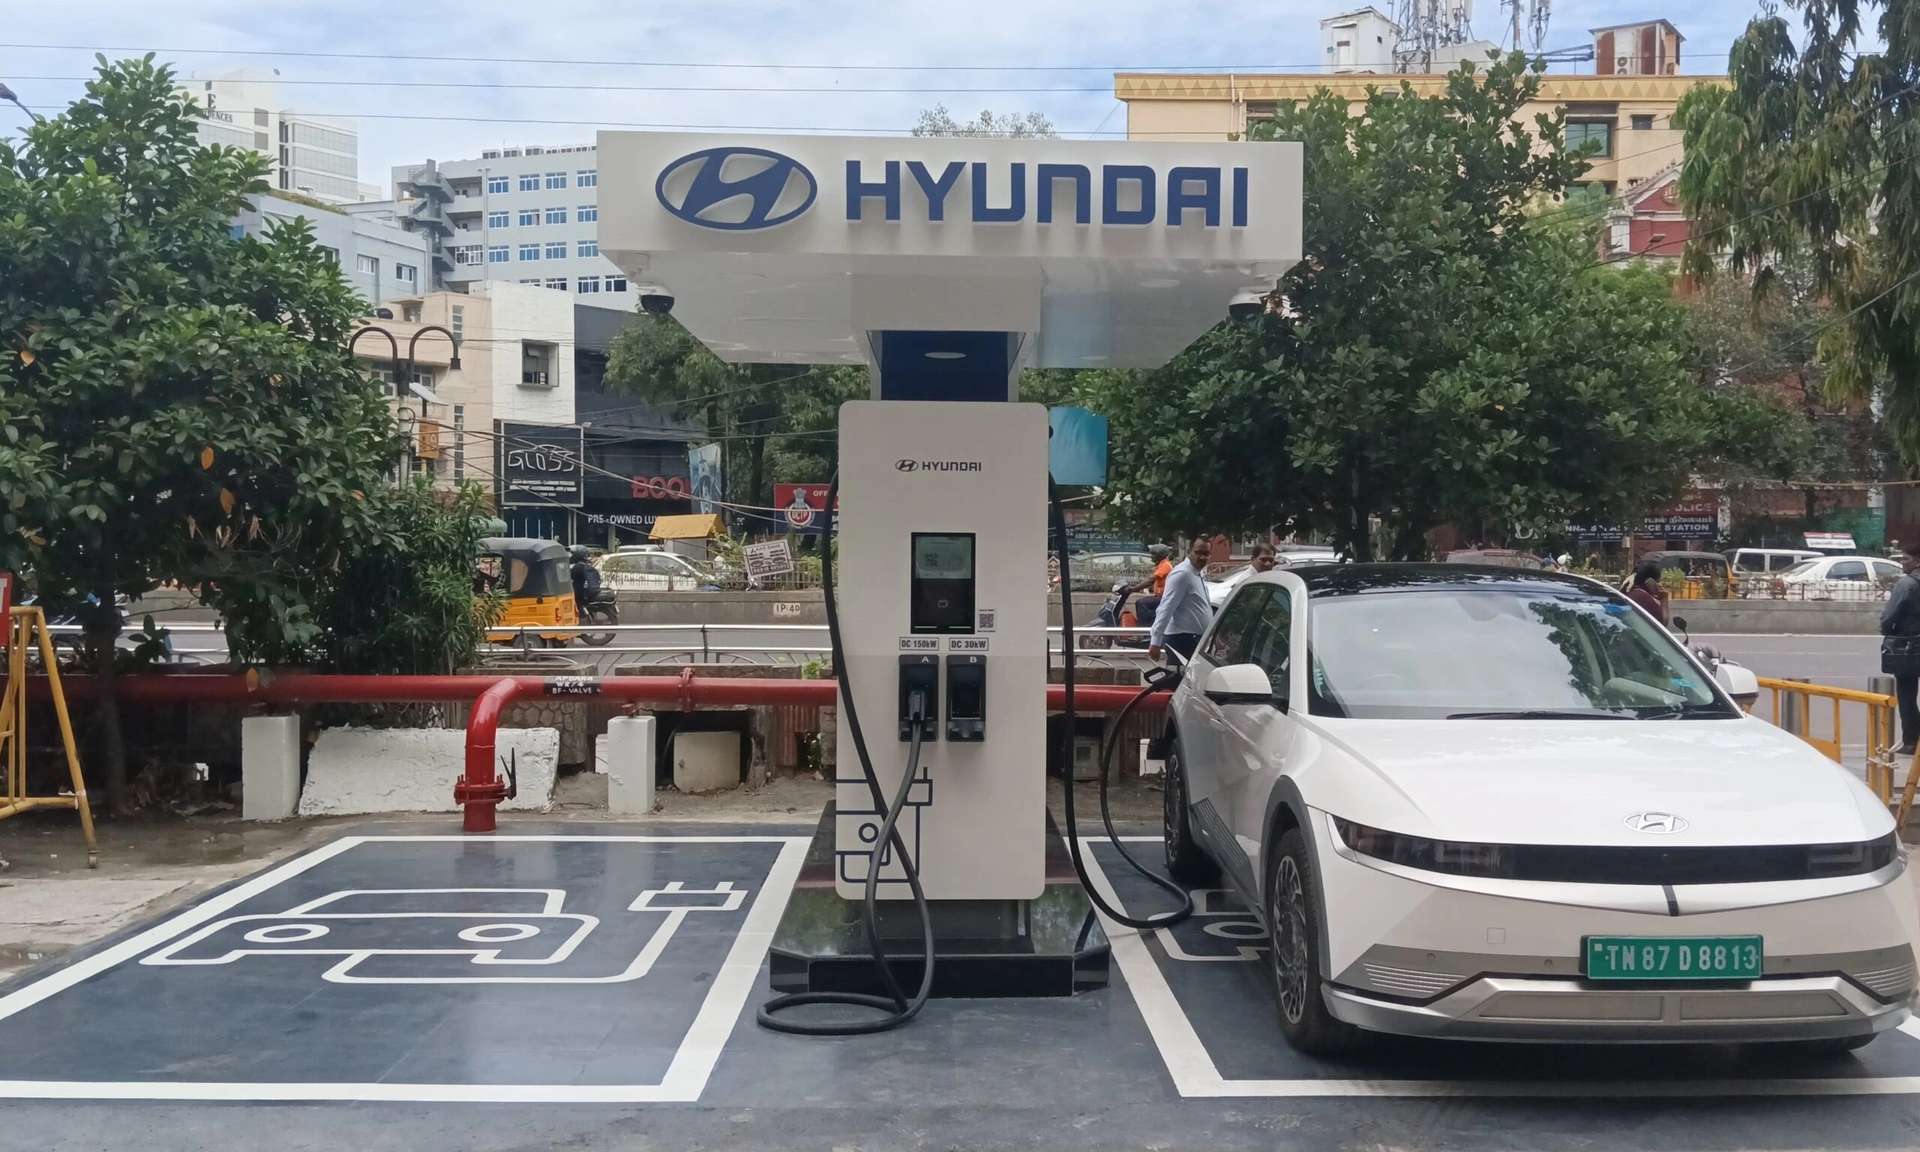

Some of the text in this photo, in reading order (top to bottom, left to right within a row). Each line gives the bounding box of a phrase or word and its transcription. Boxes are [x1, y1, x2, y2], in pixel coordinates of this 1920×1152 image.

[846, 160, 1248, 227] HYUNDAI
[922, 461, 982, 472] HYUNDAI
[1664, 524, 1709, 532] STATION
[901, 640, 937, 648] DC 150kW
[951, 640, 987, 648] DC 30kW
[1607, 944, 1757, 971] TN 87 D 8813
